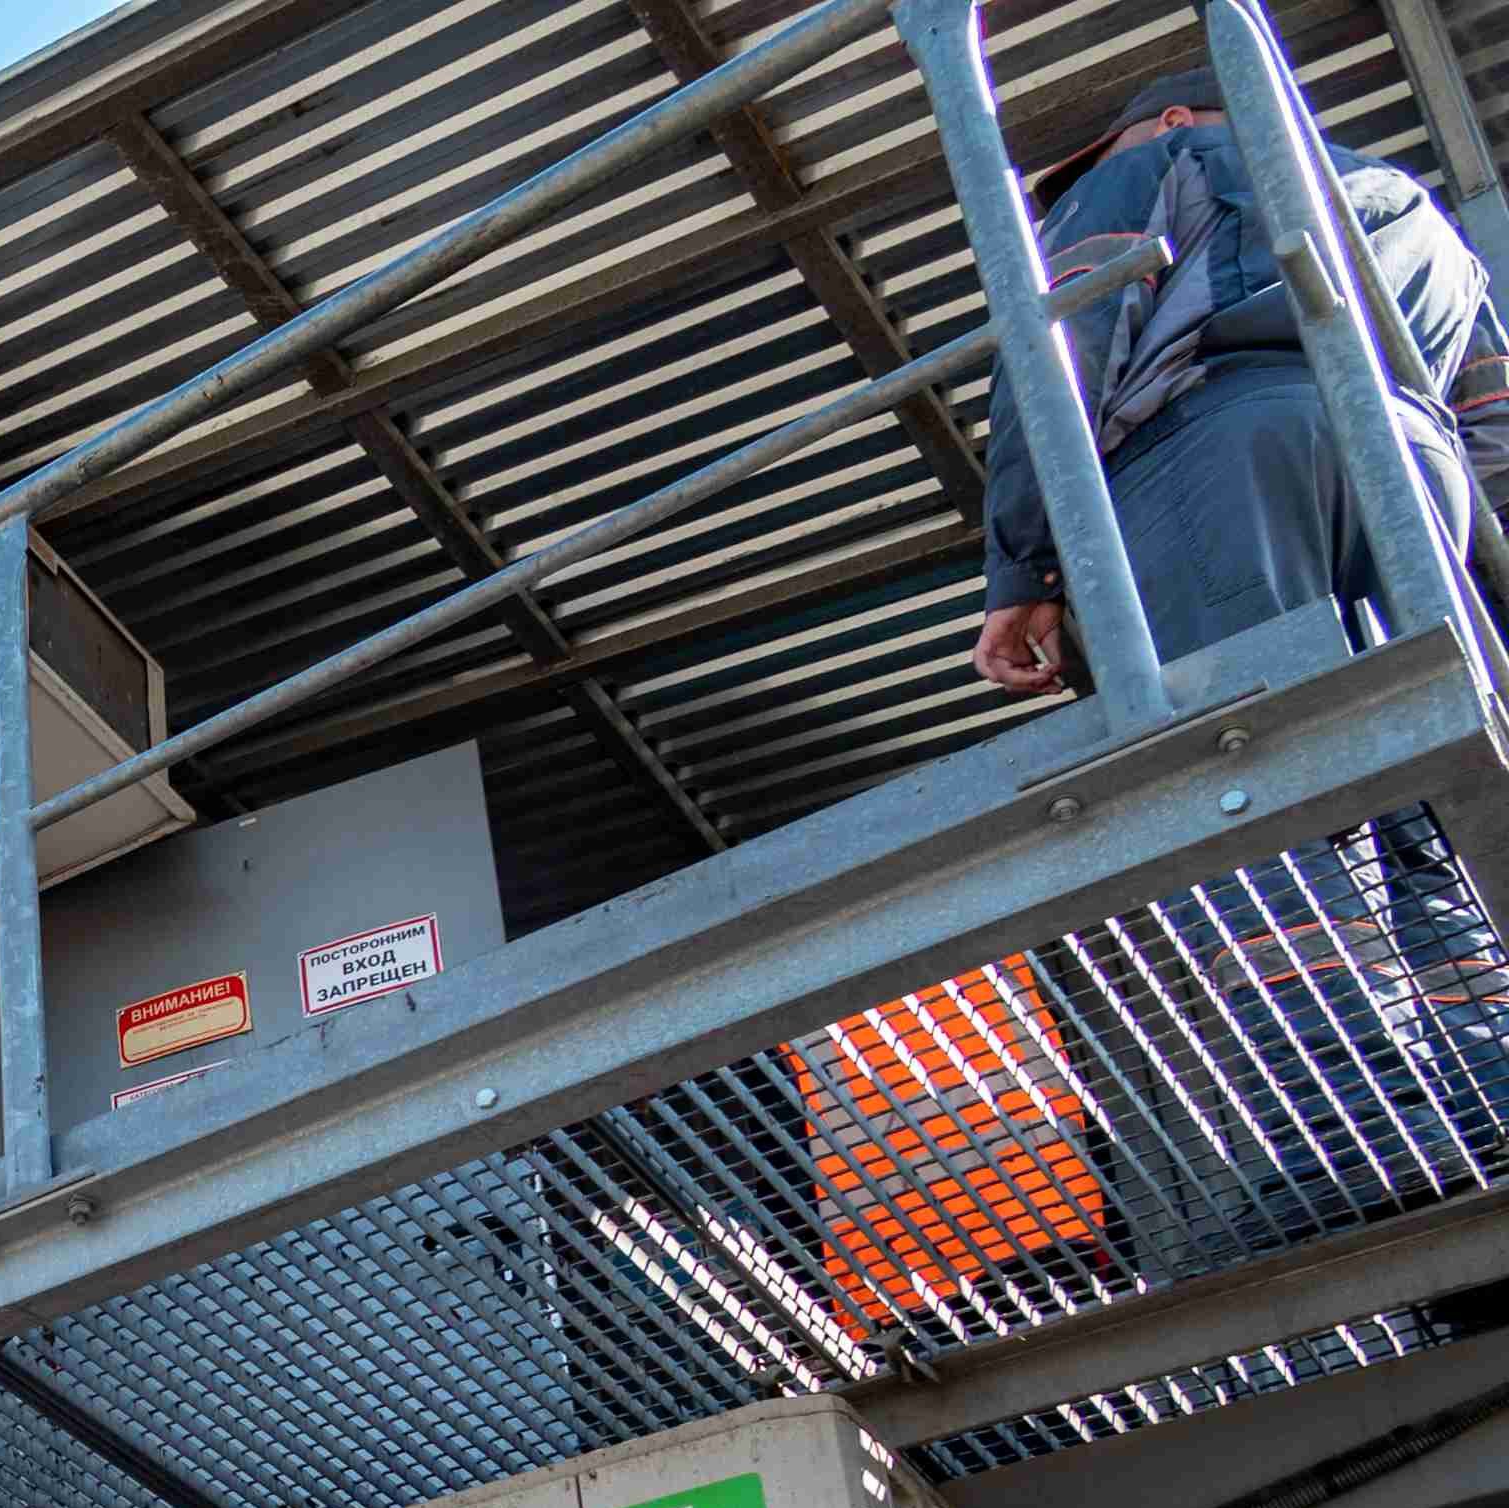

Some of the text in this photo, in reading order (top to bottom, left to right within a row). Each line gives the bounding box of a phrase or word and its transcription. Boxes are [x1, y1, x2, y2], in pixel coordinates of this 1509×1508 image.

[310, 925, 426, 967] ПОСТОРОННИМ
[342, 949, 396, 975] ВХОД
[131, 981, 231, 1023] ВНИМАНИЕ!
[316, 960, 427, 1002] ЗАПРЕЩЕН
